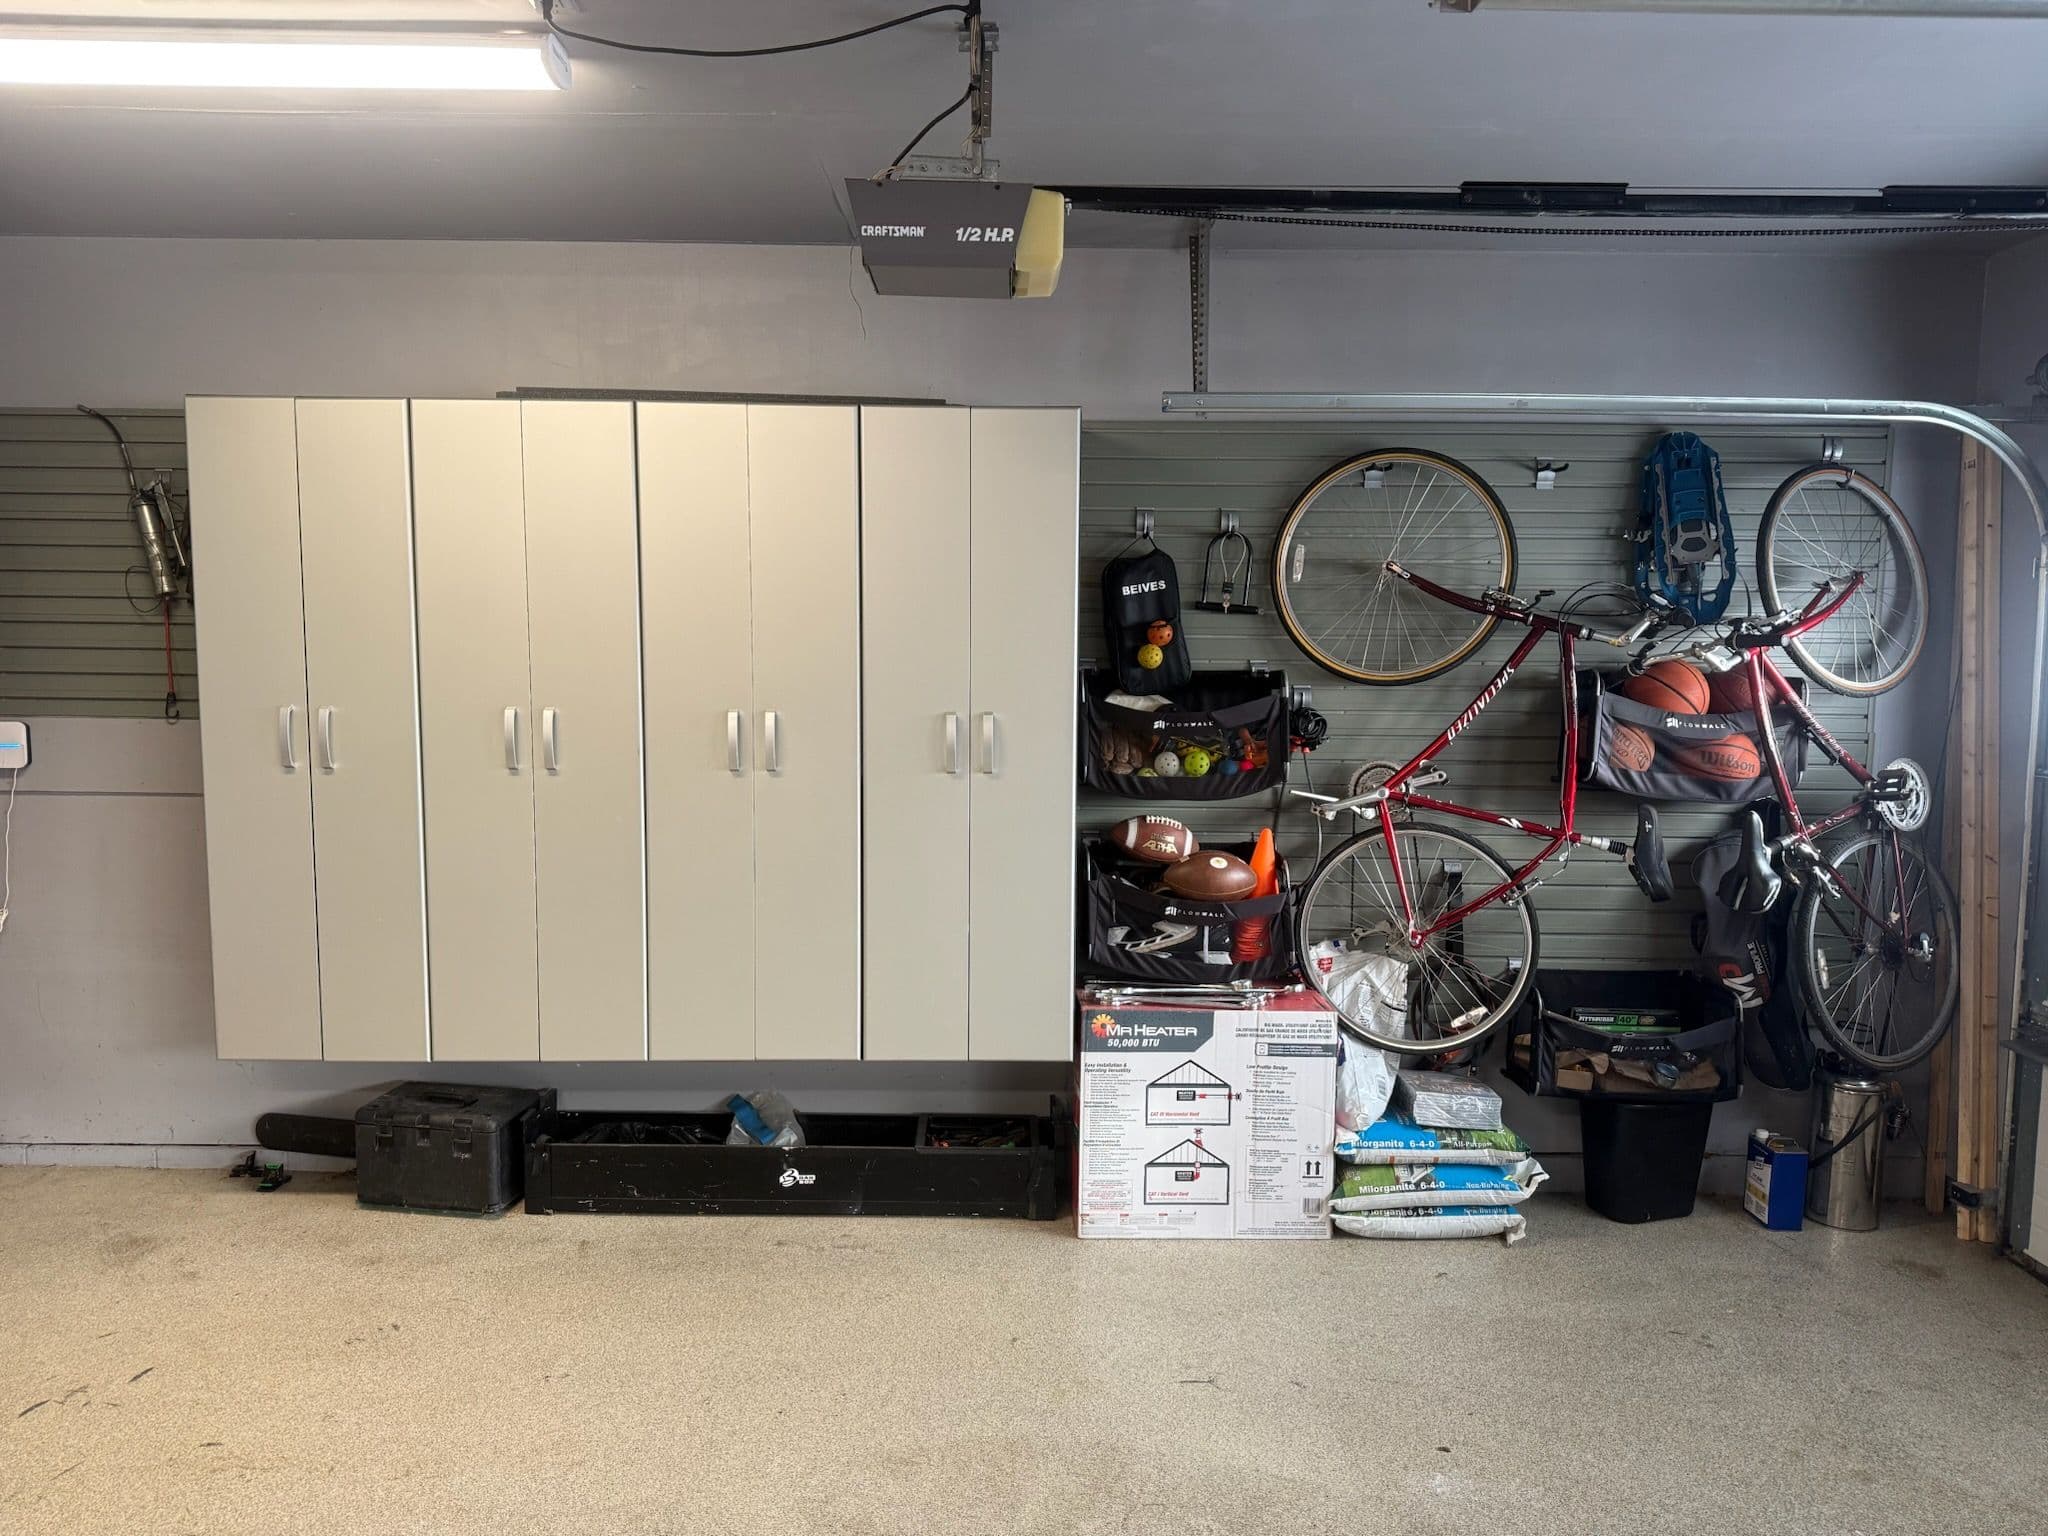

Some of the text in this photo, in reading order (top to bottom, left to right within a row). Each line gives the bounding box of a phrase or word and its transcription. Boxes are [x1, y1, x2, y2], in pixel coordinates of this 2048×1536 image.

[861, 225, 926, 237] CRAFTSMAN
[956, 227, 1014, 242] 1/2 H.P.
[1122, 580, 1166, 596] BEIVES
[1447, 663, 1515, 741] SPECIALIZED
[1701, 751, 1755, 773] Wilson
[1142, 839, 1178, 854] ALPHA
[1135, 1024, 1197, 1036] HEATER
[1107, 1038, 1160, 1048] 50,000 BTU
[1409, 1140, 1435, 1148] 6-4-0
[1359, 1181, 1446, 1194] Milorganite 6-4-0
[1418, 1208, 1443, 1216] 6-4-0
